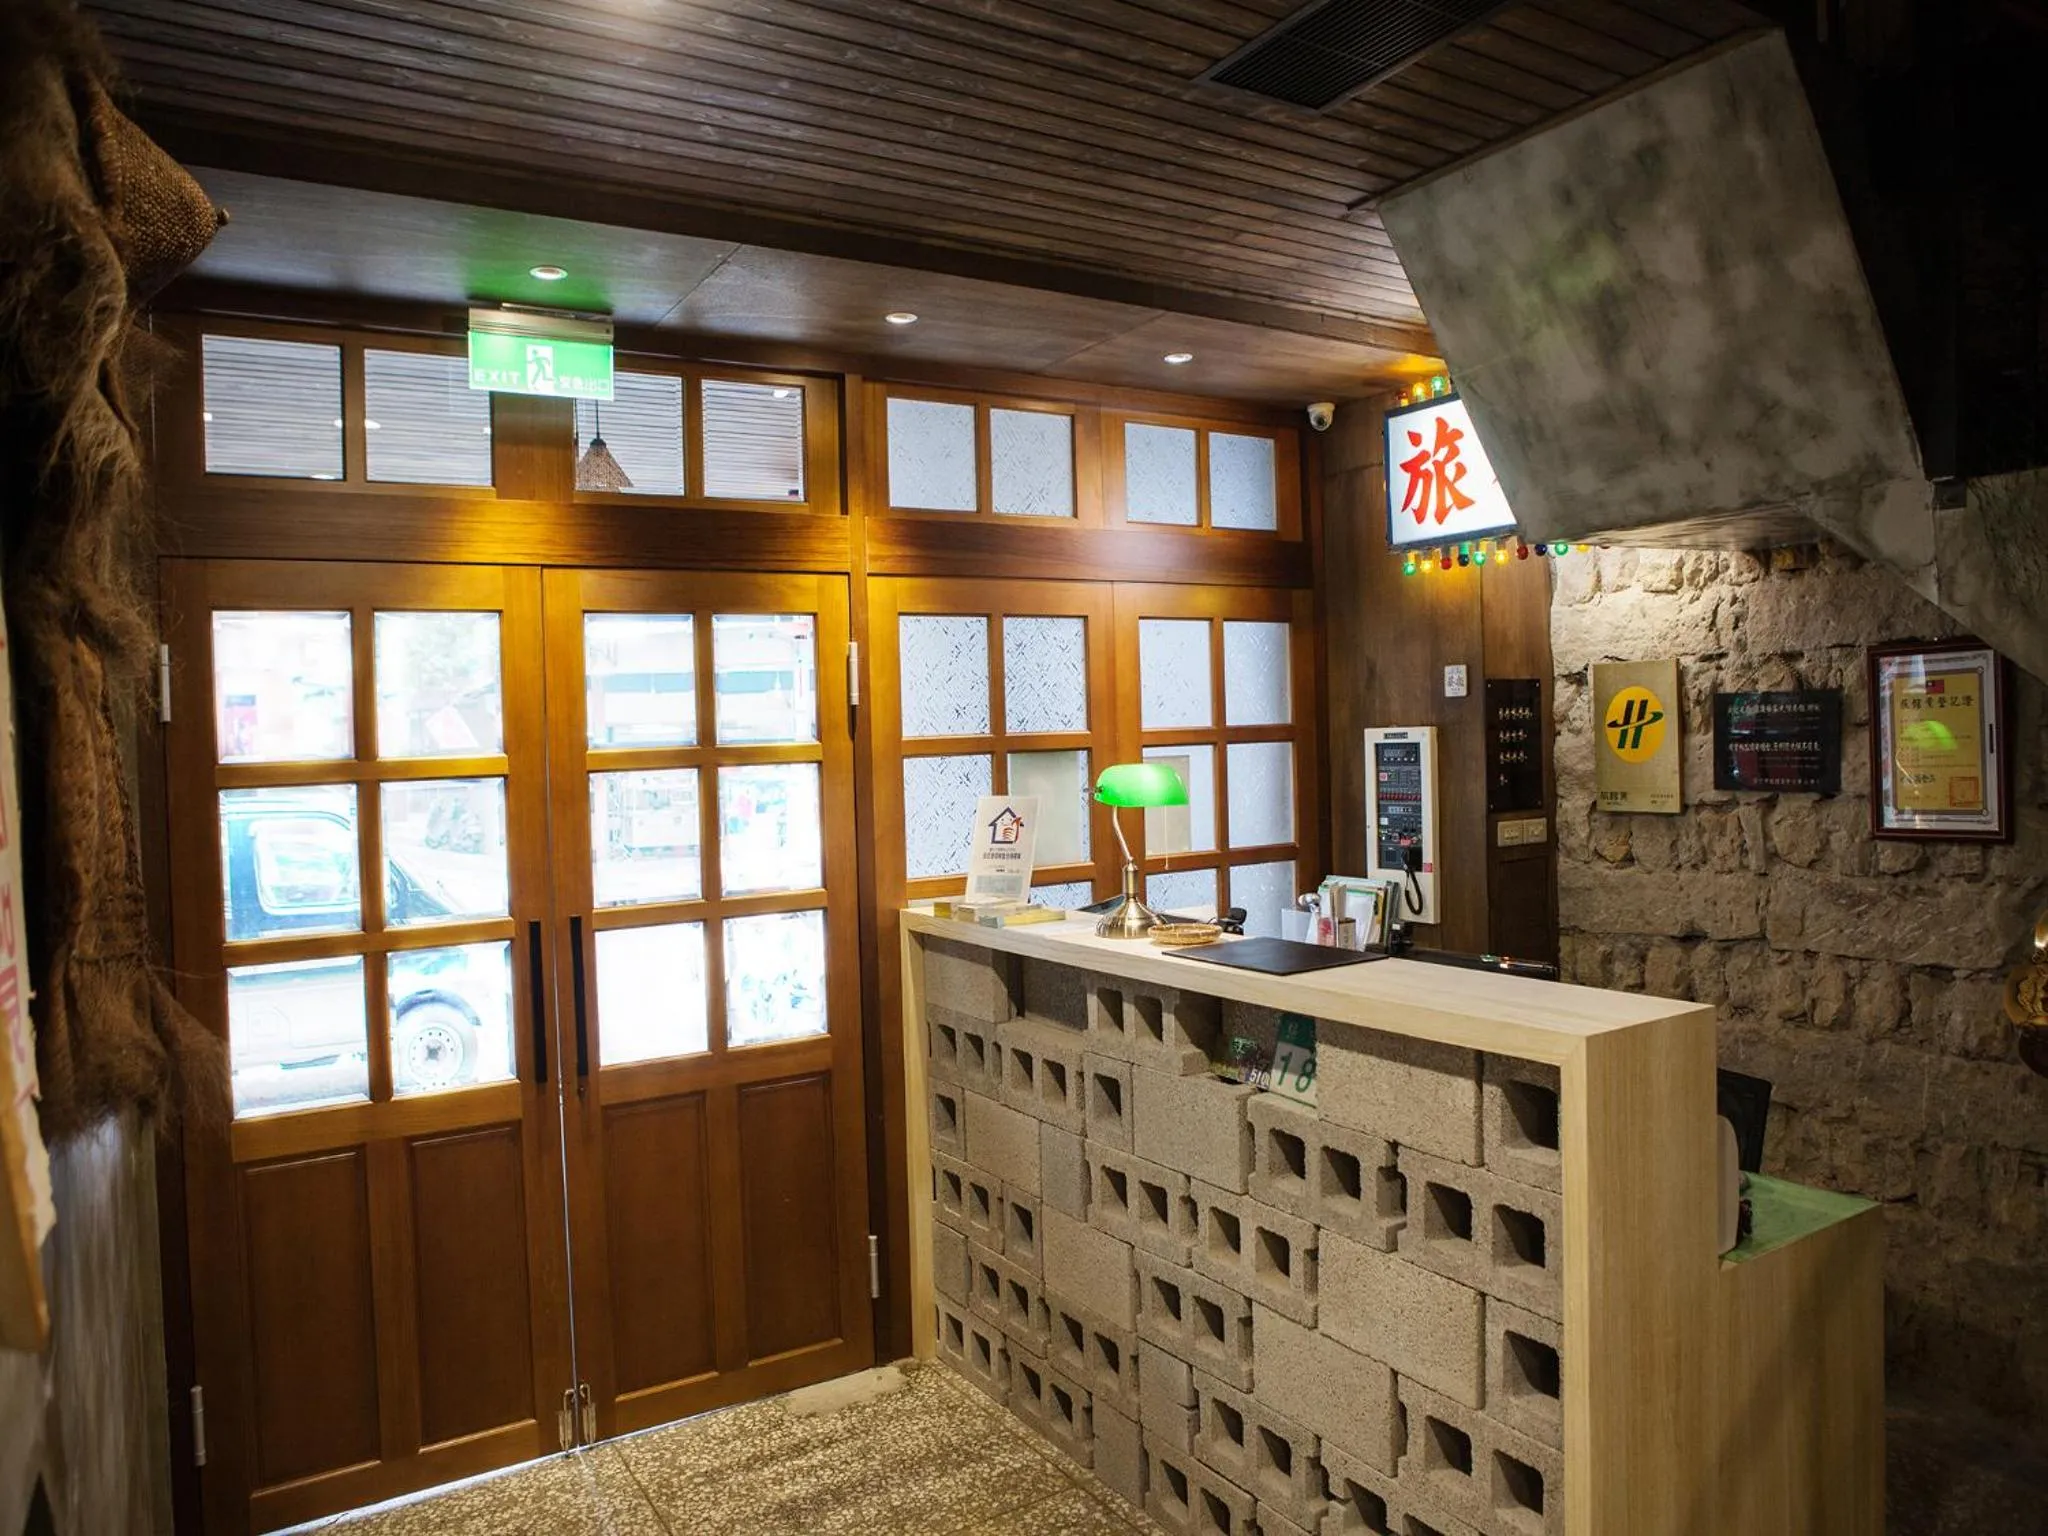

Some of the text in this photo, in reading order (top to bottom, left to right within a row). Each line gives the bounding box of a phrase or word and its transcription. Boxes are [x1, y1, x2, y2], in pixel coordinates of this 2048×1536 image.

[472, 368, 520, 386] EXIT
[1399, 416, 1498, 525] 旅
[1277, 1051, 1317, 1093] 18
